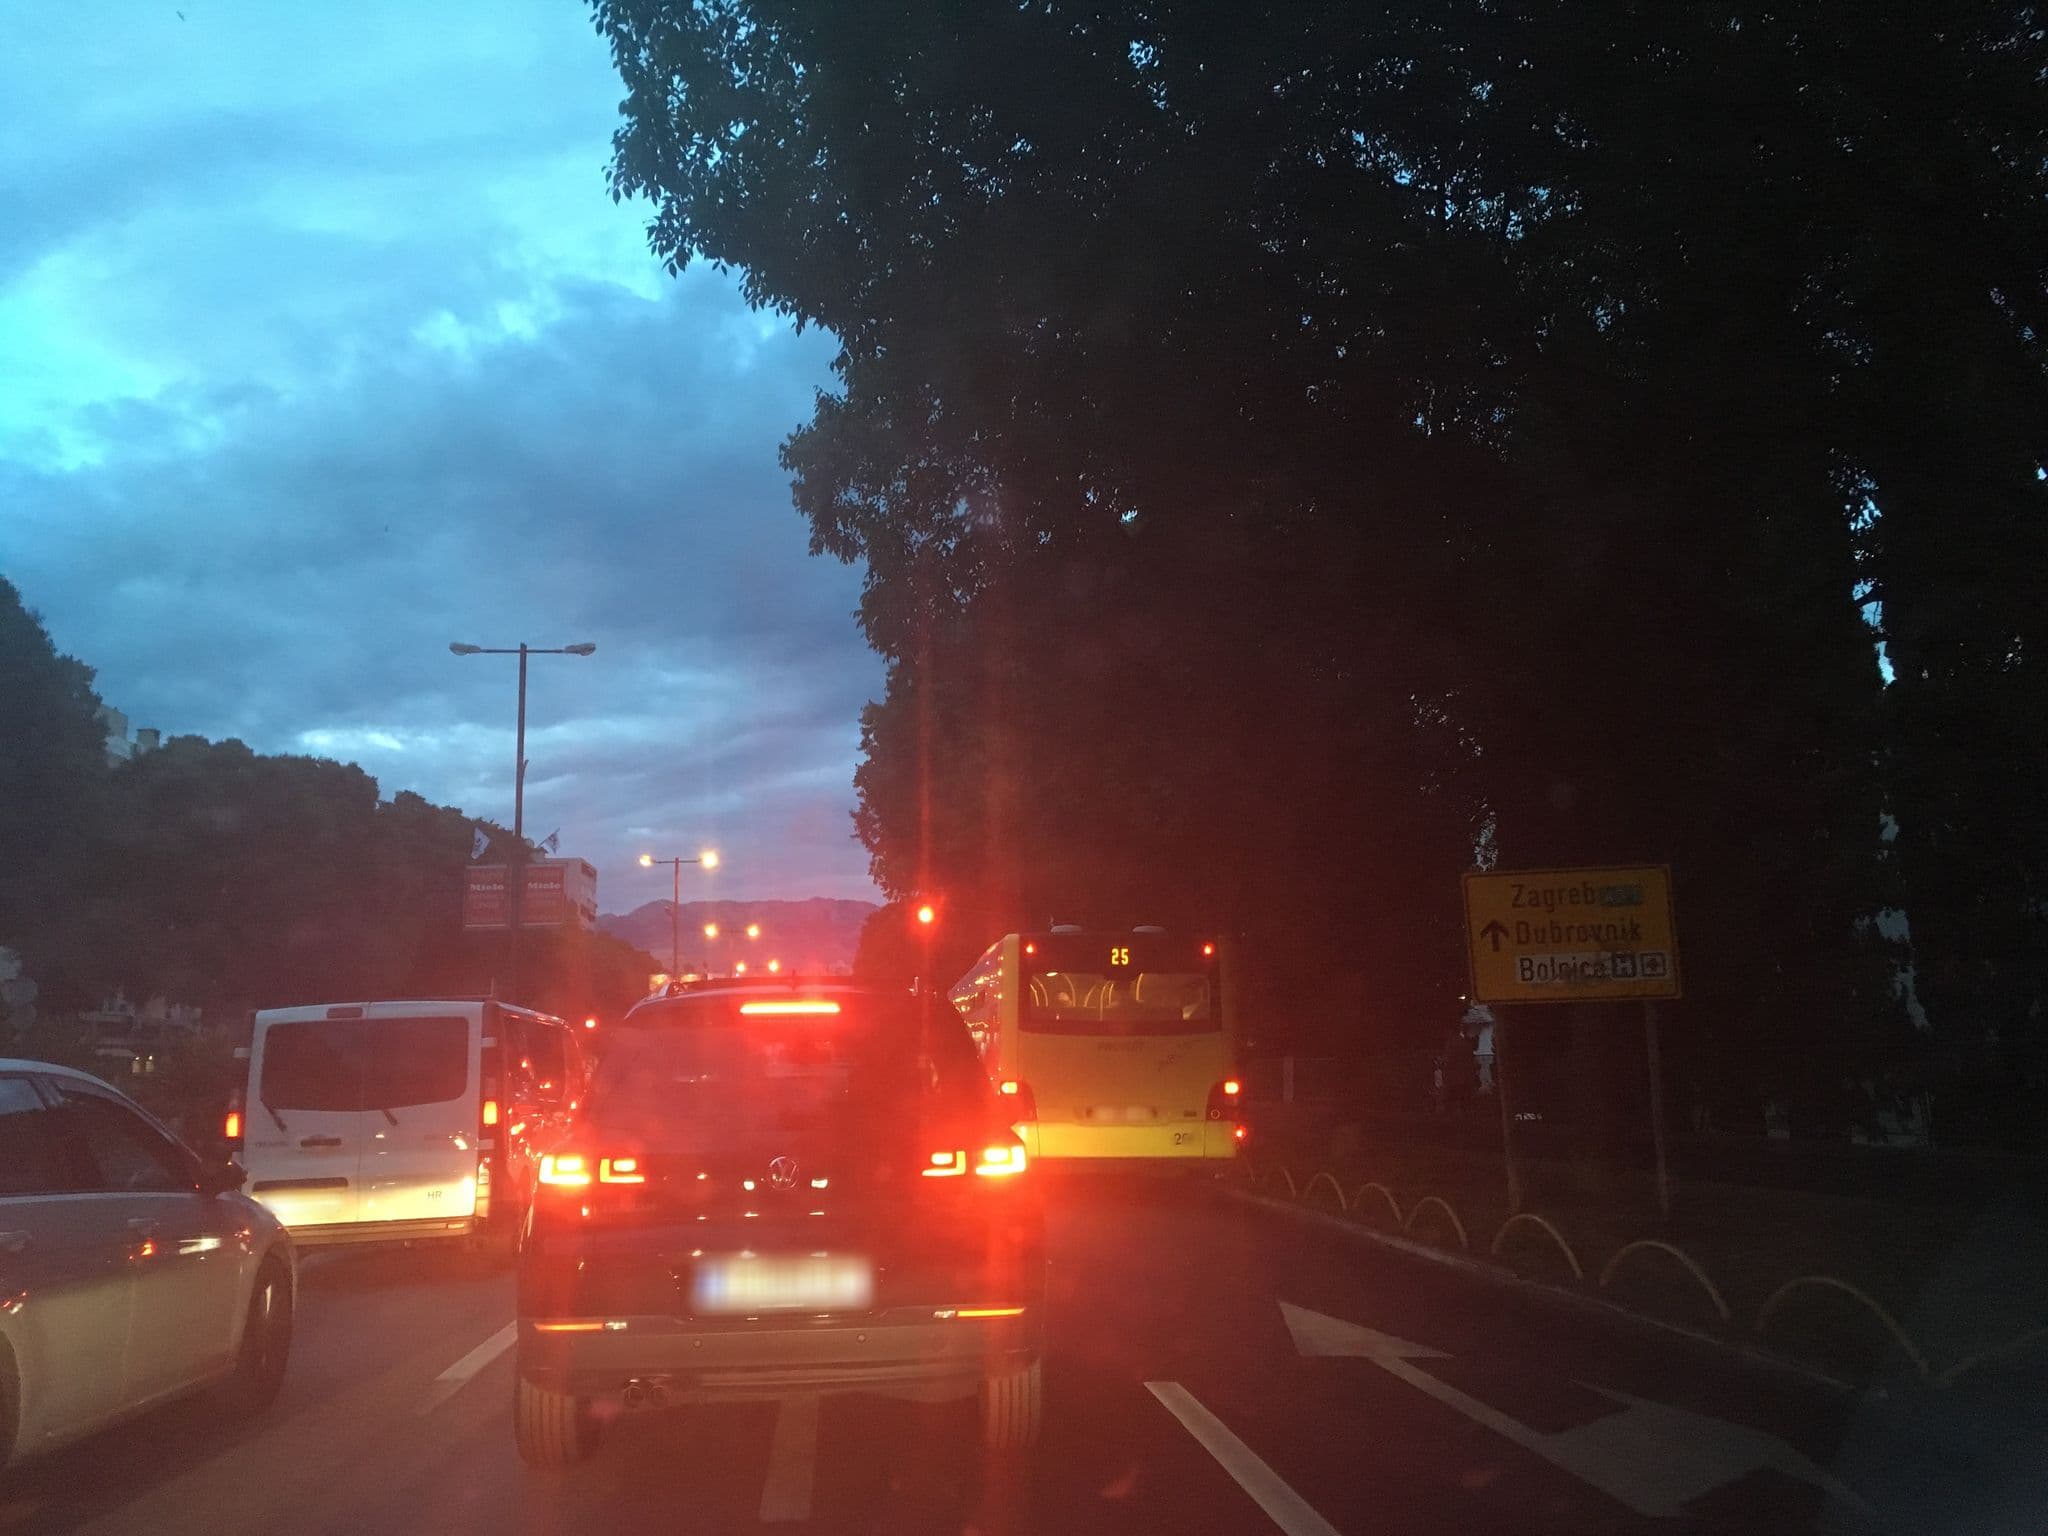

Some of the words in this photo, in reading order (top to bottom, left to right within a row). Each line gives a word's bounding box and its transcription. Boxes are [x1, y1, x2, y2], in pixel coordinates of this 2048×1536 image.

[1511, 881, 1596, 913] Zagreb
[1516, 917, 1642, 945] Dubrovnik
[1111, 948, 1129, 965] 25
[427, 1190, 442, 1200] HR
